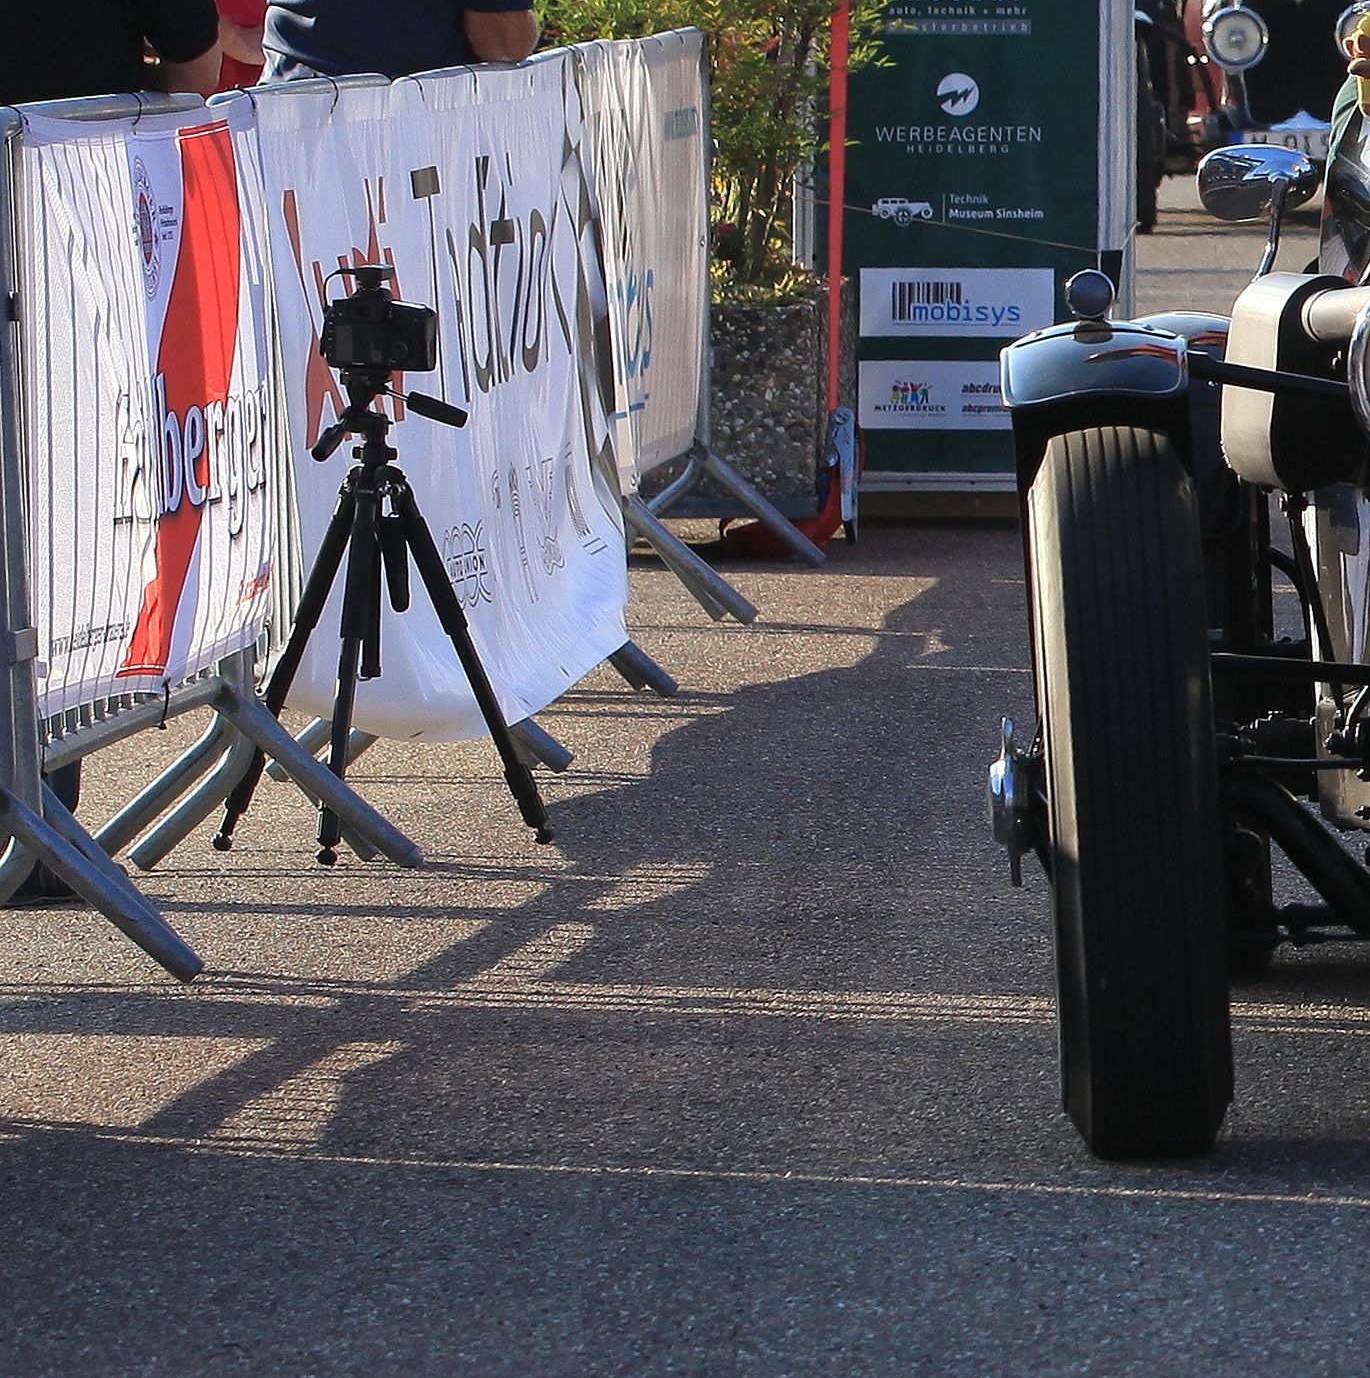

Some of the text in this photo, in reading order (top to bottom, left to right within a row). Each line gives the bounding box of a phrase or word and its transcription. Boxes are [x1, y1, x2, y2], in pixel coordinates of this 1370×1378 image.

[875, 125, 1042, 142] WERBEAGENTEN
[906, 143, 1010, 154] HEIDELBERG
[949, 193, 989, 205] Technik
[949, 207, 1045, 219] Museum Sinsheim
[912, 299, 1021, 327] mobisys
